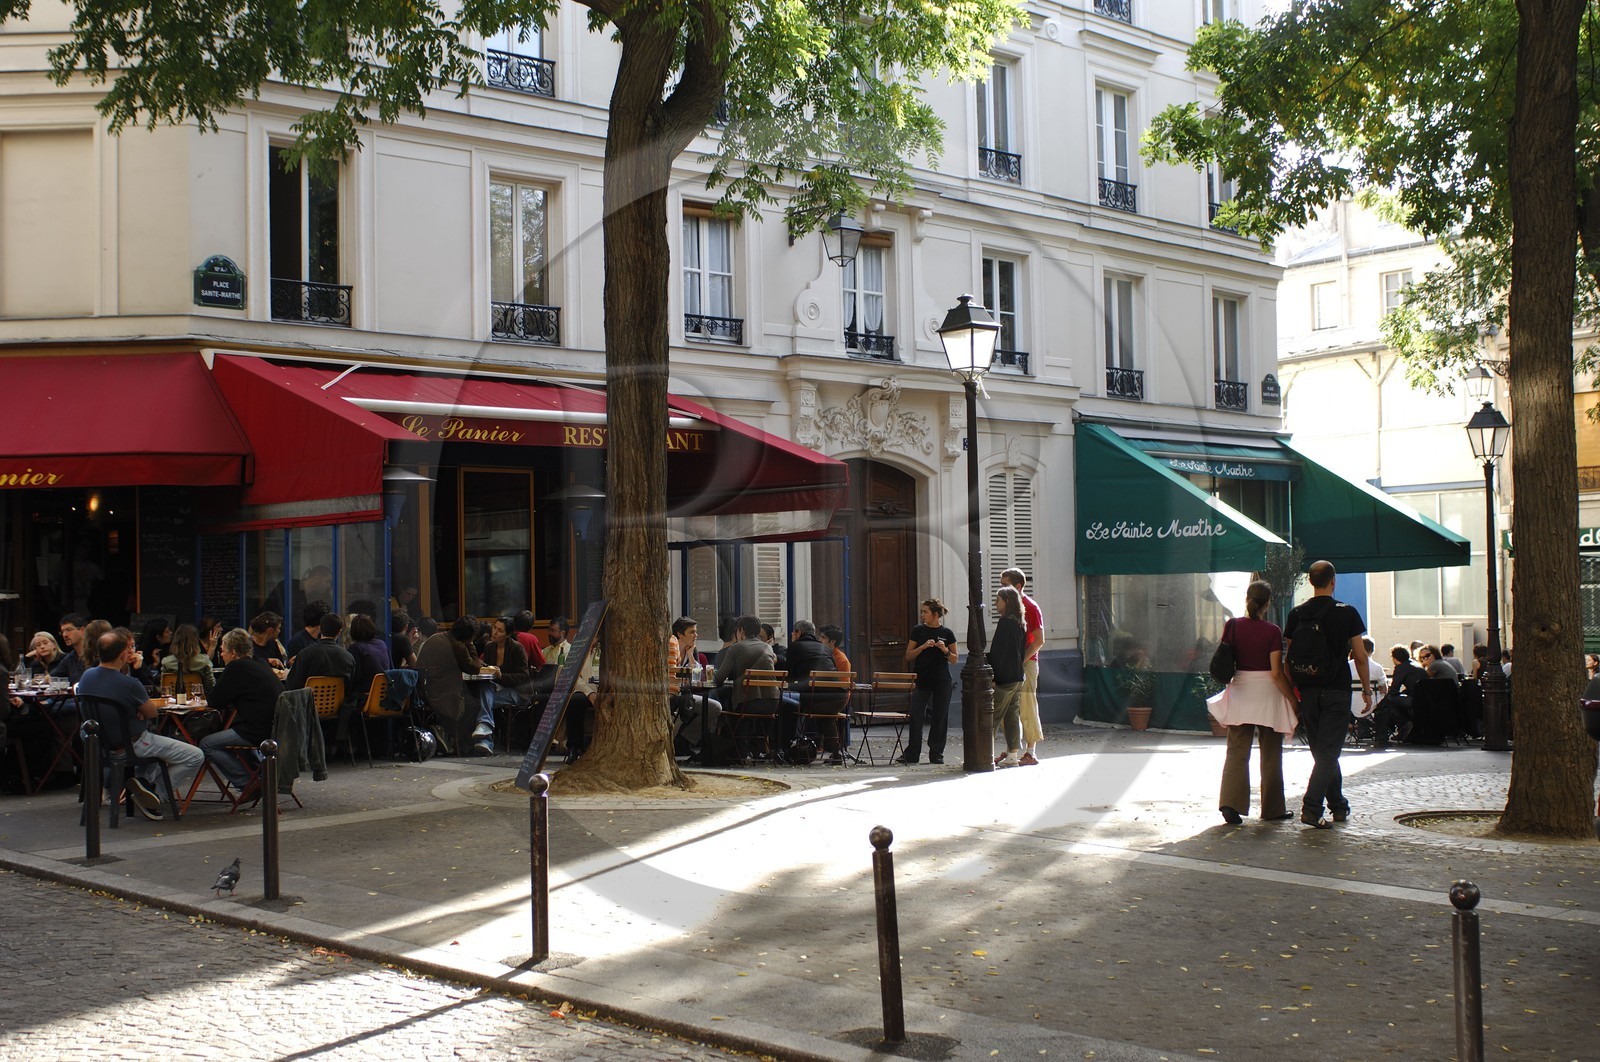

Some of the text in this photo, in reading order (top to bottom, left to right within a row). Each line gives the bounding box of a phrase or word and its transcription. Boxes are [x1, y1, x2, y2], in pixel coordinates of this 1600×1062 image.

[201, 290, 241, 299] SAINTE-MARTHE
[438, 417, 526, 442] Panier
[1111, 520, 1153, 539] Sainte
[1157, 518, 1227, 539] Marthe
